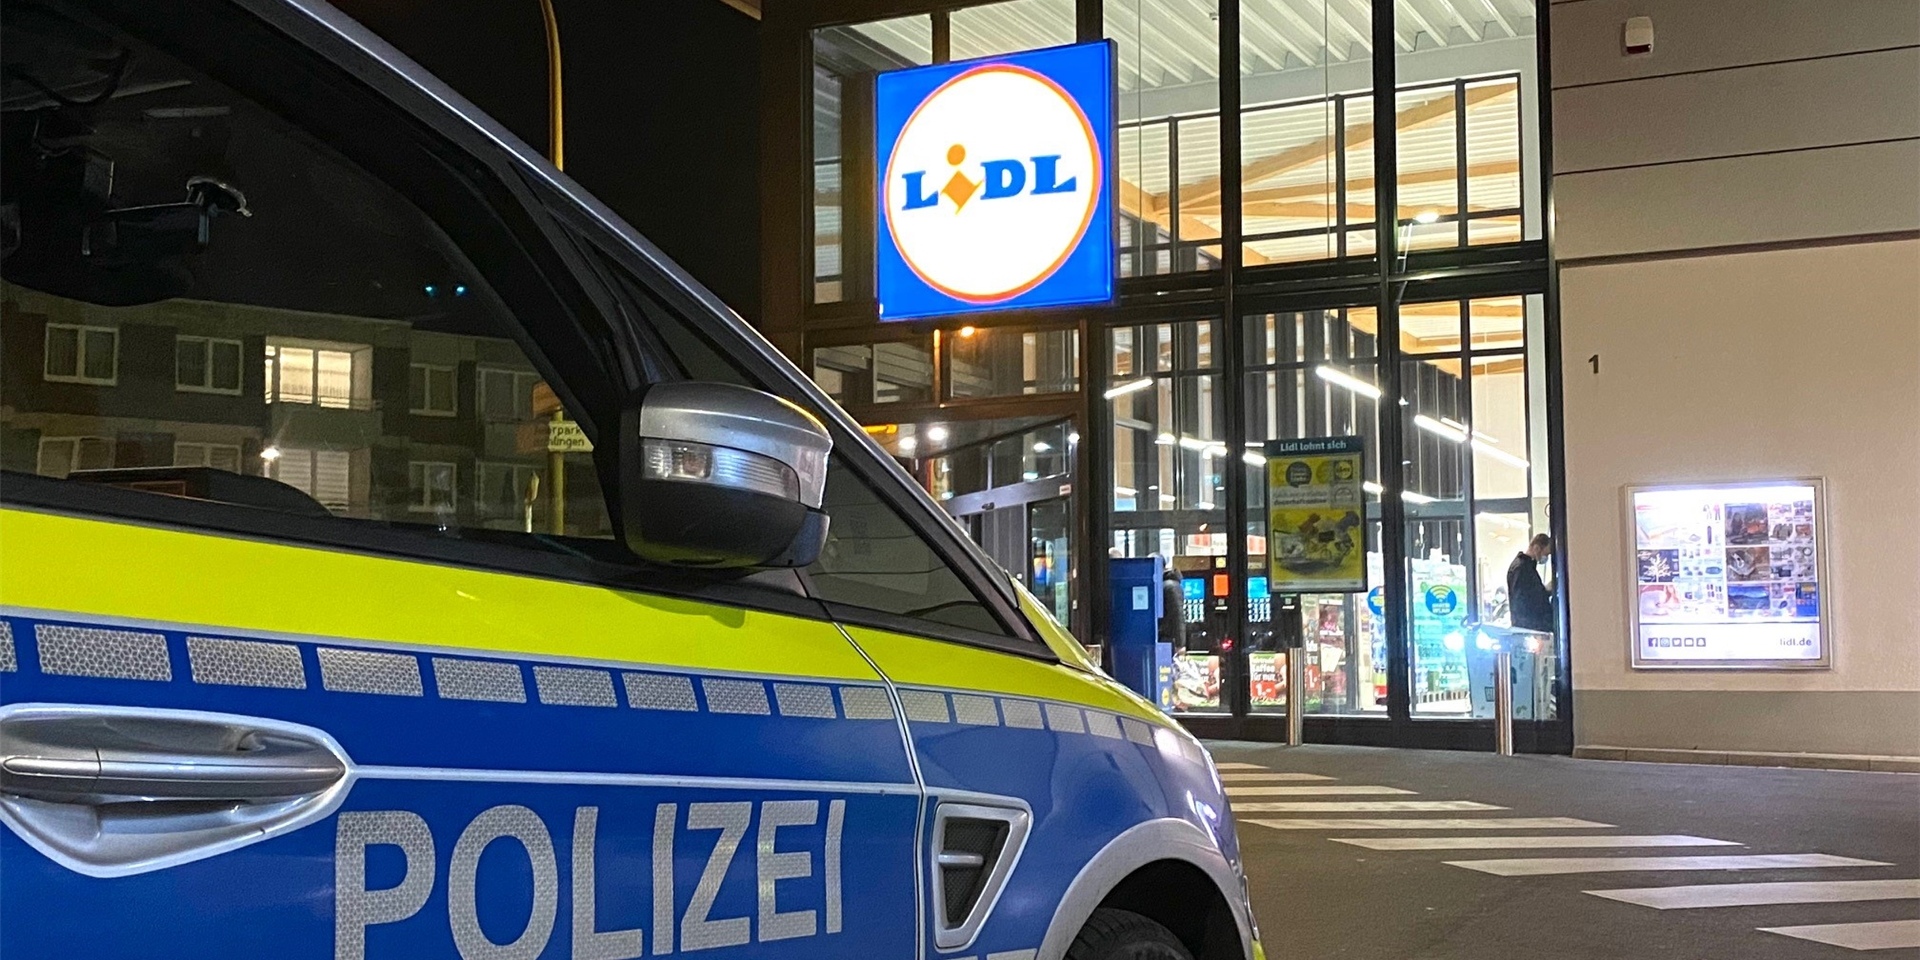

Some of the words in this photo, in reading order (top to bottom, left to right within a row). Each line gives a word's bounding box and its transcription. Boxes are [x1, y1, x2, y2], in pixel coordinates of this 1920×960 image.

[1588, 354, 1599, 375] 1
[1280, 443, 1298, 452] Lidl
[1300, 441, 1325, 451] lohnt
[1327, 440, 1347, 449] sich
[1779, 637, 1812, 646] lidl.de
[334, 800, 843, 960] POLIZEI
